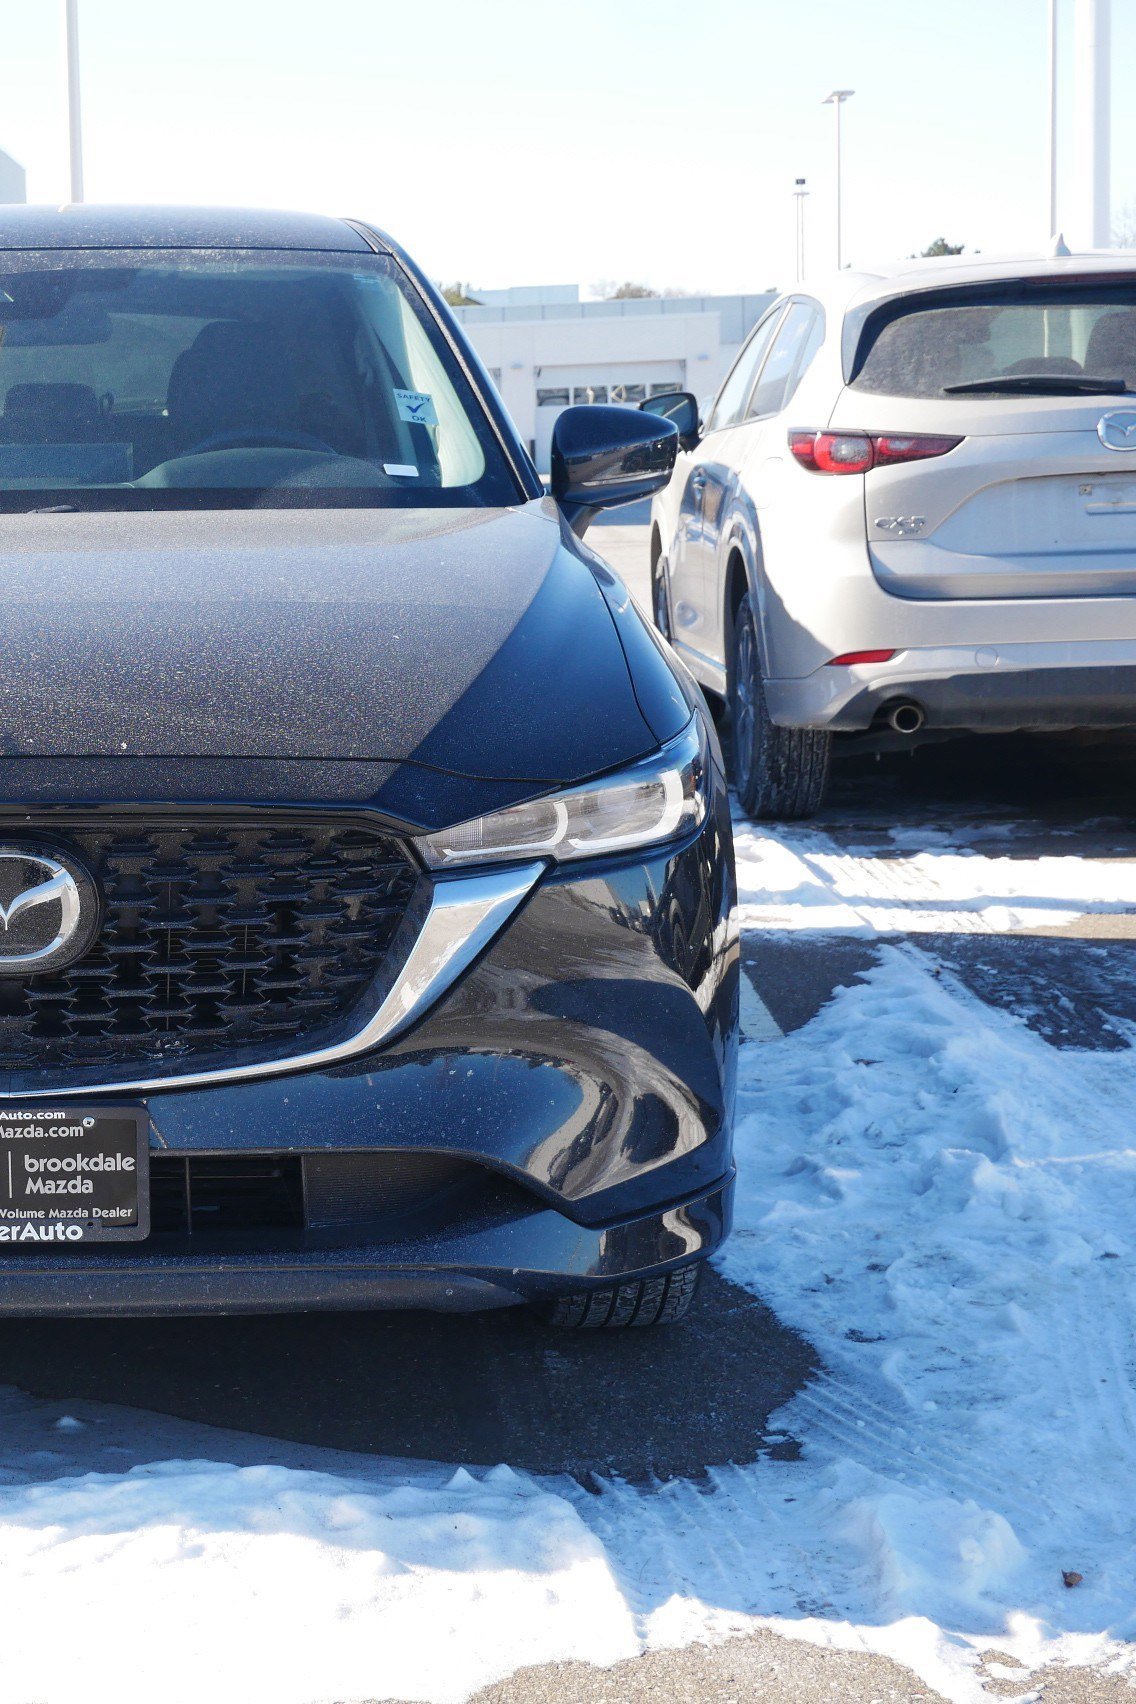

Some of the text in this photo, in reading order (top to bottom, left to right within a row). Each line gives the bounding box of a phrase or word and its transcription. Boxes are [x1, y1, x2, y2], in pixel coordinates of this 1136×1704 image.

[396, 393, 431, 403] SAFETY
[874, 515, 925, 529] CX-5
[24, 1153, 136, 1172] brookdale
[25, 1176, 94, 1194] Mazda
[0, 1208, 46, 1220] Volume
[48, 1208, 89, 1219] Mazda
[92, 1207, 132, 1218] Dealer
